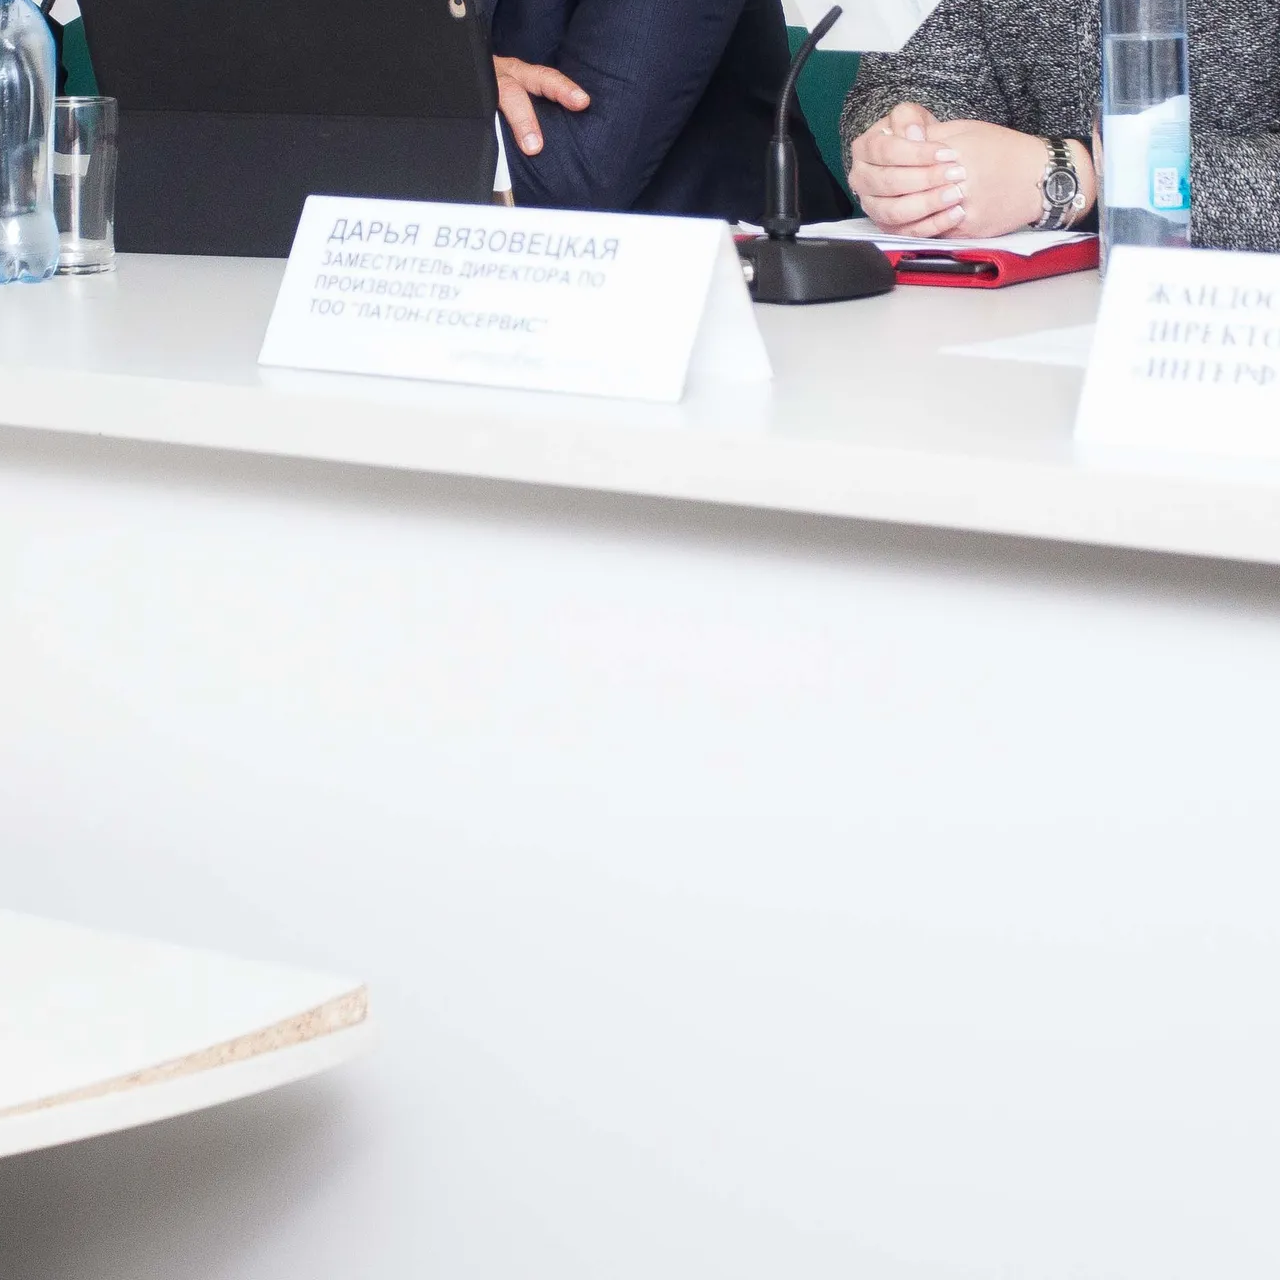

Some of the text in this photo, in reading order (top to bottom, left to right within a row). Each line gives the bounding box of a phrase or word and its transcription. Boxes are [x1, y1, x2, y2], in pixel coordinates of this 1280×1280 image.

[327, 218, 620, 261] ДАРЬЯ ВЯЗОВЕЦКАЯ
[321, 250, 607, 289] ЗАМЕСТИТЕЛЬ ДИРЕКТОРА ПО
[315, 274, 462, 301] ПРОИЗВОДСТВУ
[309, 299, 345, 317] ТОО
